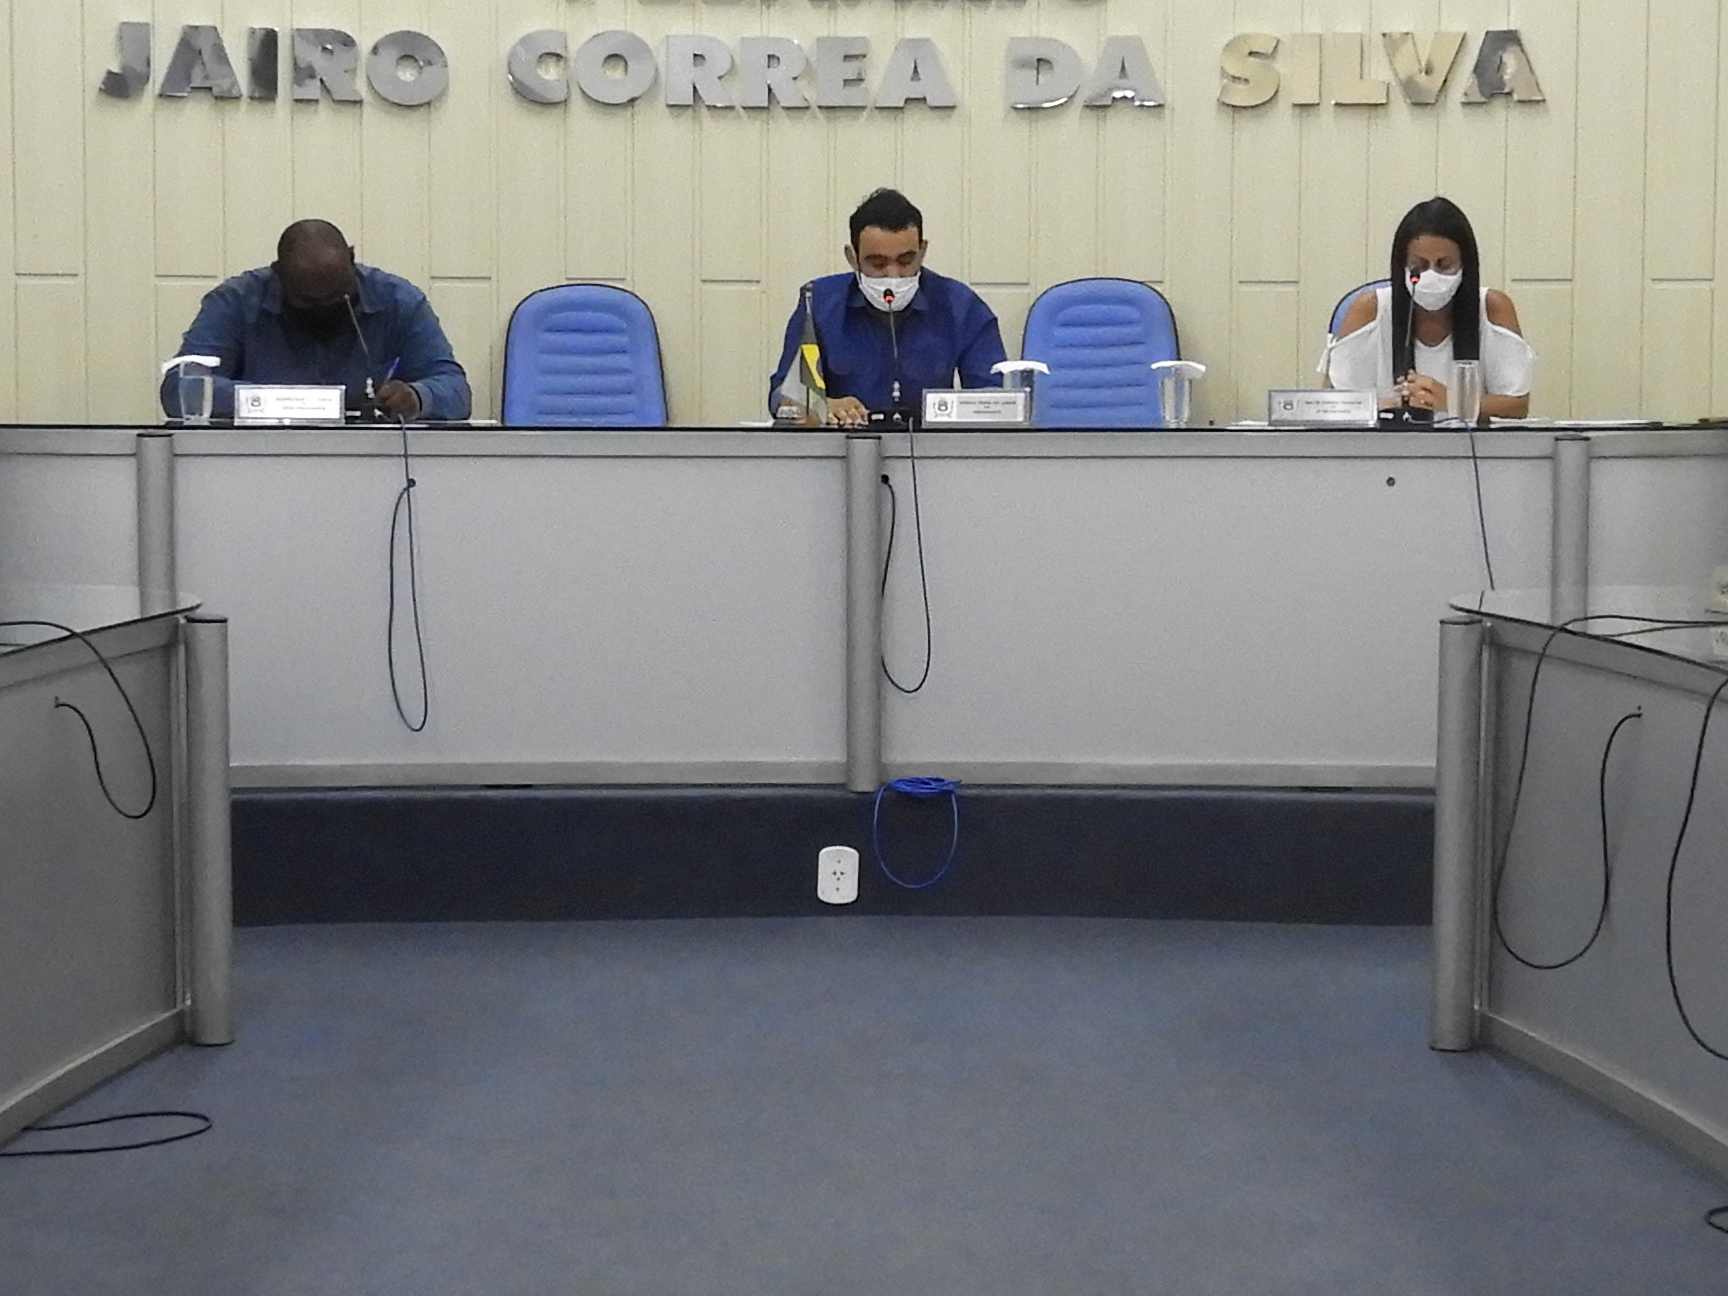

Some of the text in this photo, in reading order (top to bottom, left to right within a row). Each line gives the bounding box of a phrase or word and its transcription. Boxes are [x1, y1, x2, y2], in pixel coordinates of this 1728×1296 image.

[100, 22, 1546, 110] JAIRO CORREA DA SILVA
